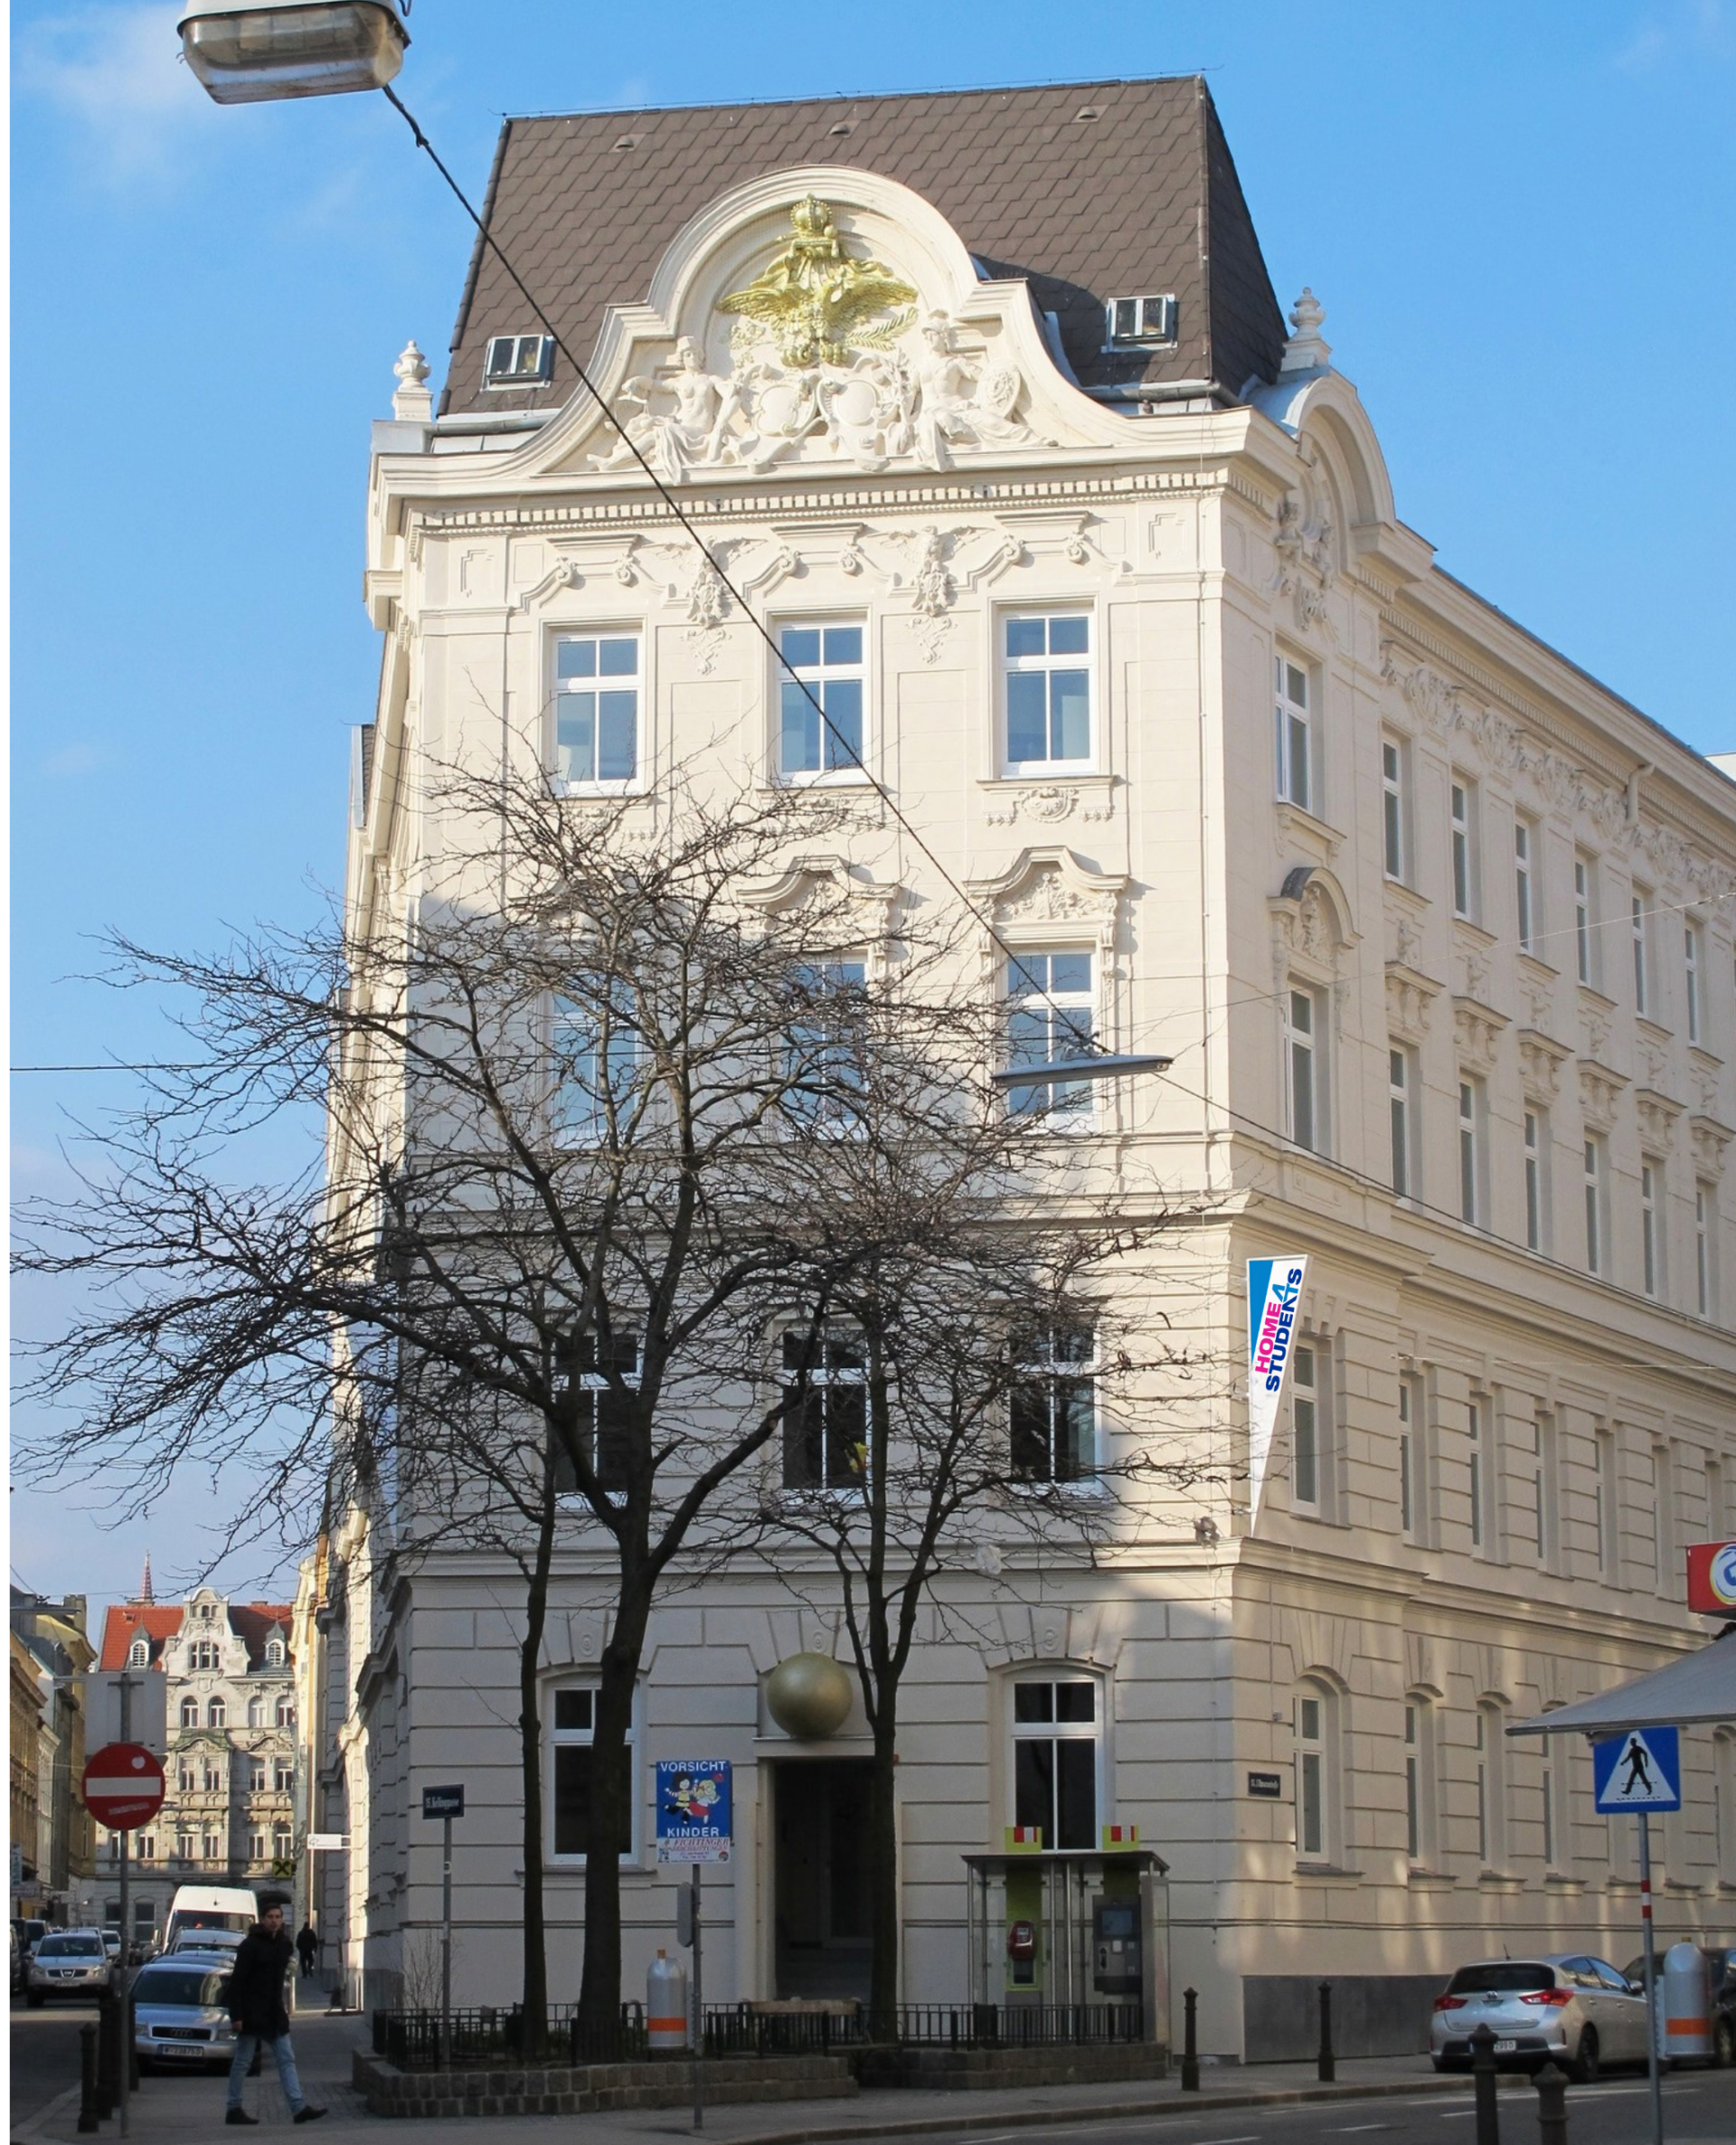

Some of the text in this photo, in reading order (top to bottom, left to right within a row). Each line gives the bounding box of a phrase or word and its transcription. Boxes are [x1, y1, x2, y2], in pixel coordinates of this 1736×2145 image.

[1266, 1269, 1302, 1393] STUDENTS
[660, 1761, 726, 1772] VORSICHT
[667, 1827, 720, 1837] KINDER
